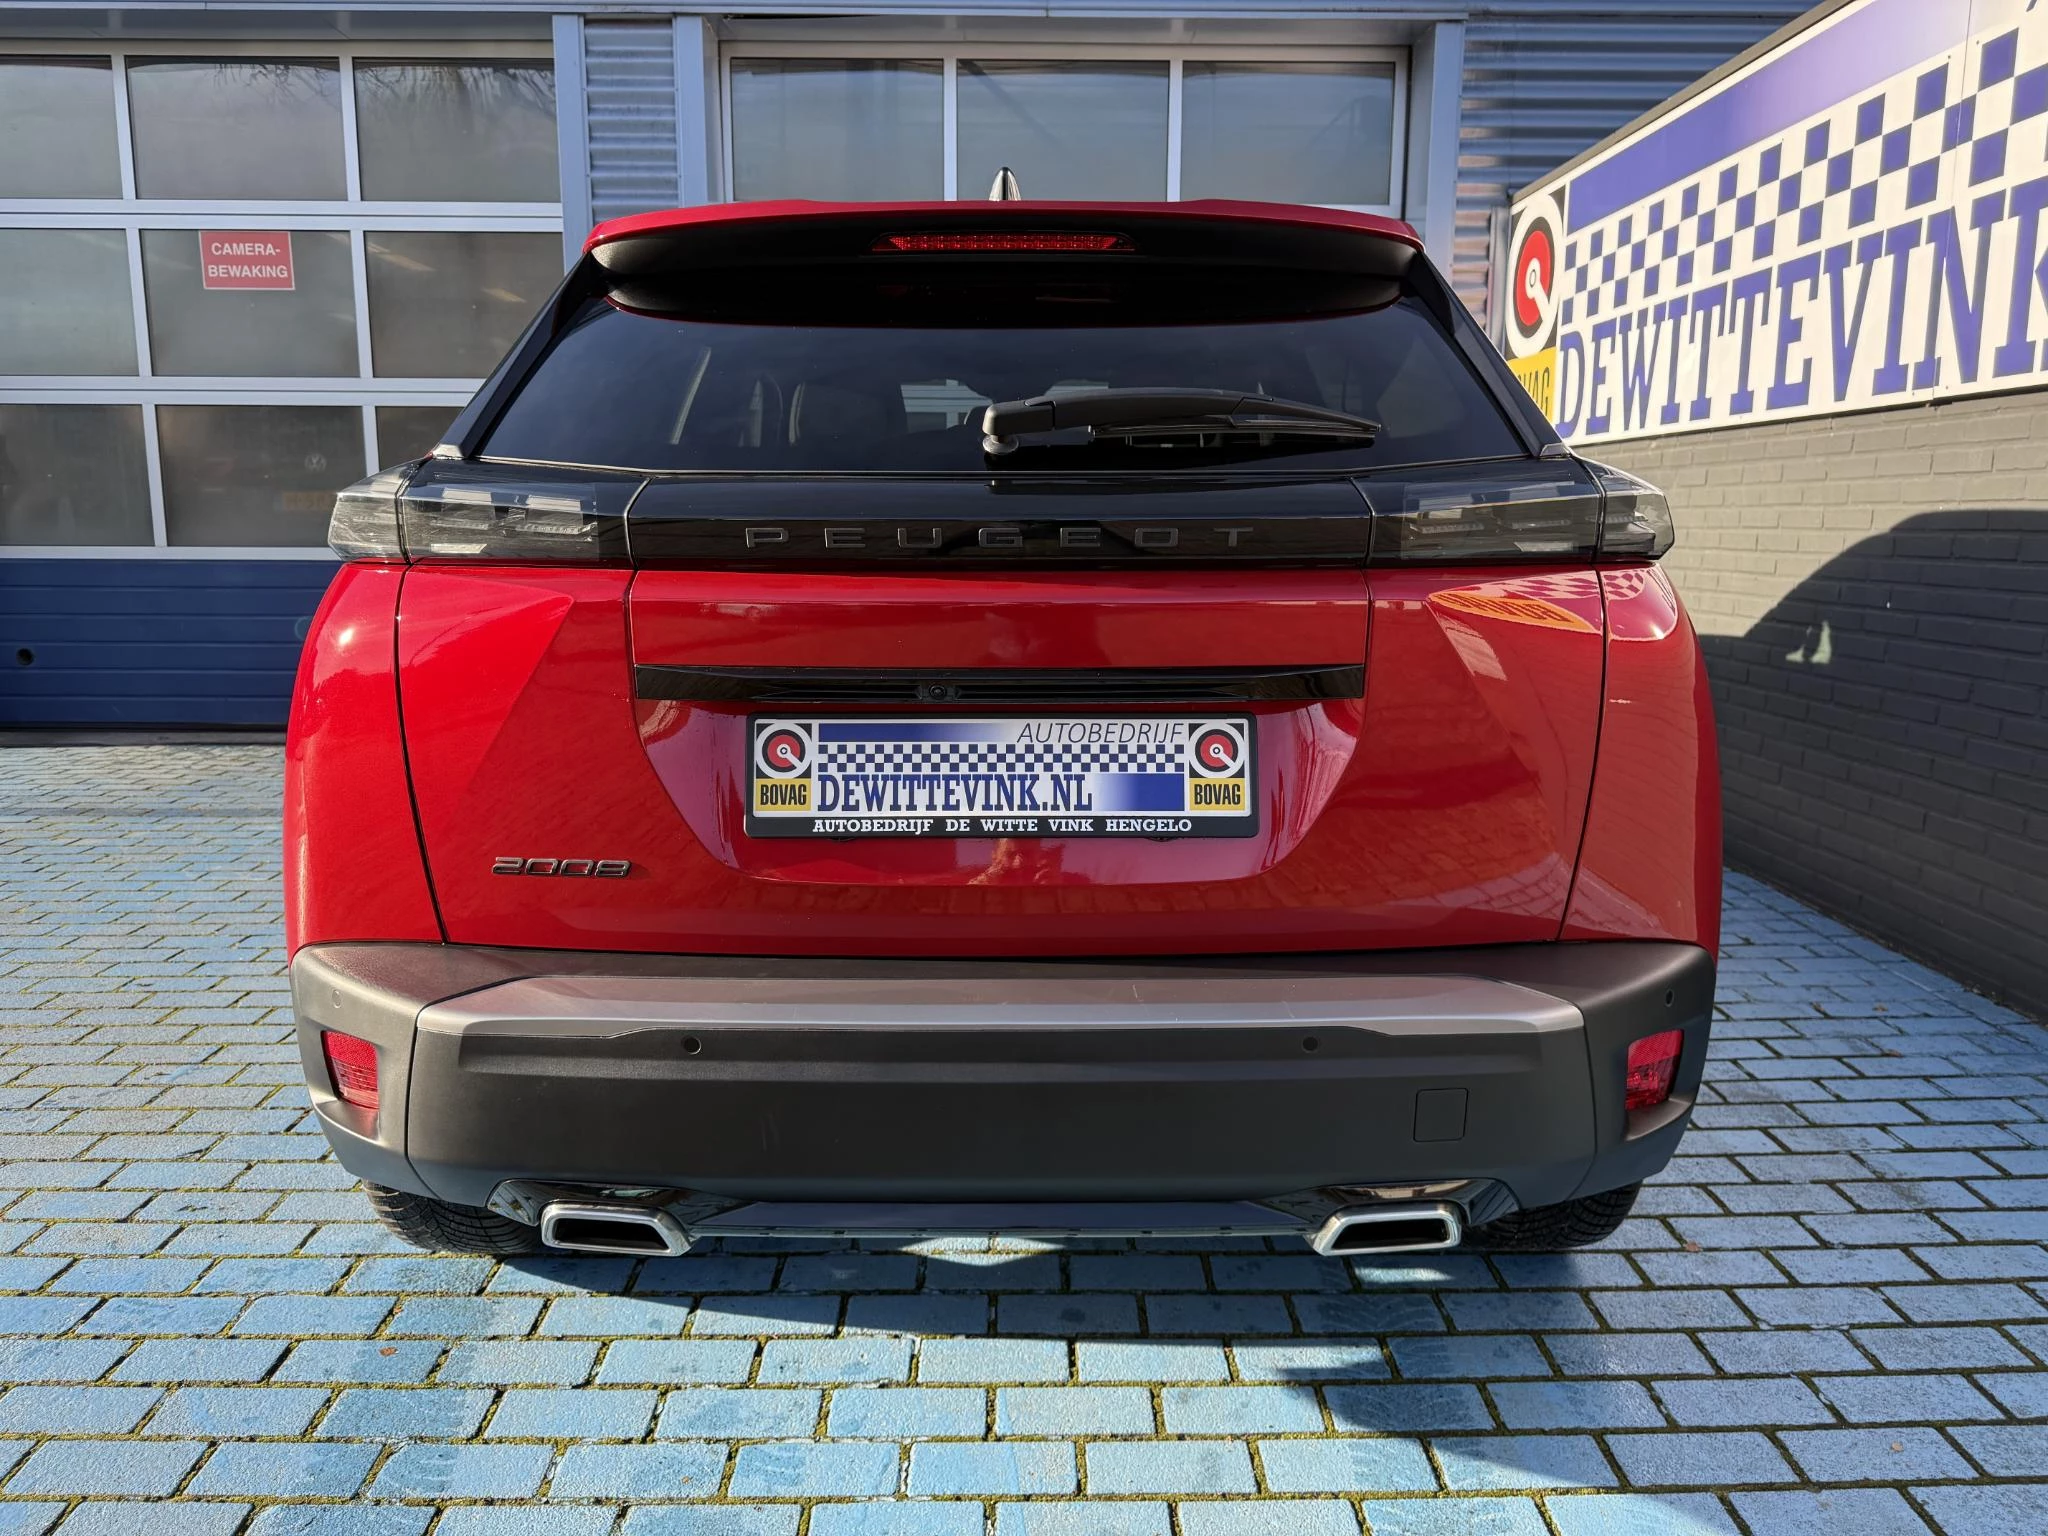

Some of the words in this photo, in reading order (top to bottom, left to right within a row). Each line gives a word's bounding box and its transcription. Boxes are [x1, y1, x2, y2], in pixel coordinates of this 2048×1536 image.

[211, 242, 281, 256] CAMERA-
[207, 264, 289, 278] BEWAKING
[1555, 174, 2048, 439] DEWITTEVINK
[745, 526, 1254, 549] PEUGEOT
[1016, 722, 1185, 744] AUTOBEDRIJF
[759, 783, 807, 806] BOVAG
[817, 773, 1093, 812] DEWITTEVINK.NL
[1193, 783, 1241, 806] BOVAG
[812, 818, 934, 835] AUTOBEDRIJF
[945, 818, 970, 832] DE
[980, 818, 1038, 832] WITTE
[1048, 818, 1094, 832] VINK
[1105, 818, 1193, 832] HENGELO
[491, 856, 632, 878] 2008
